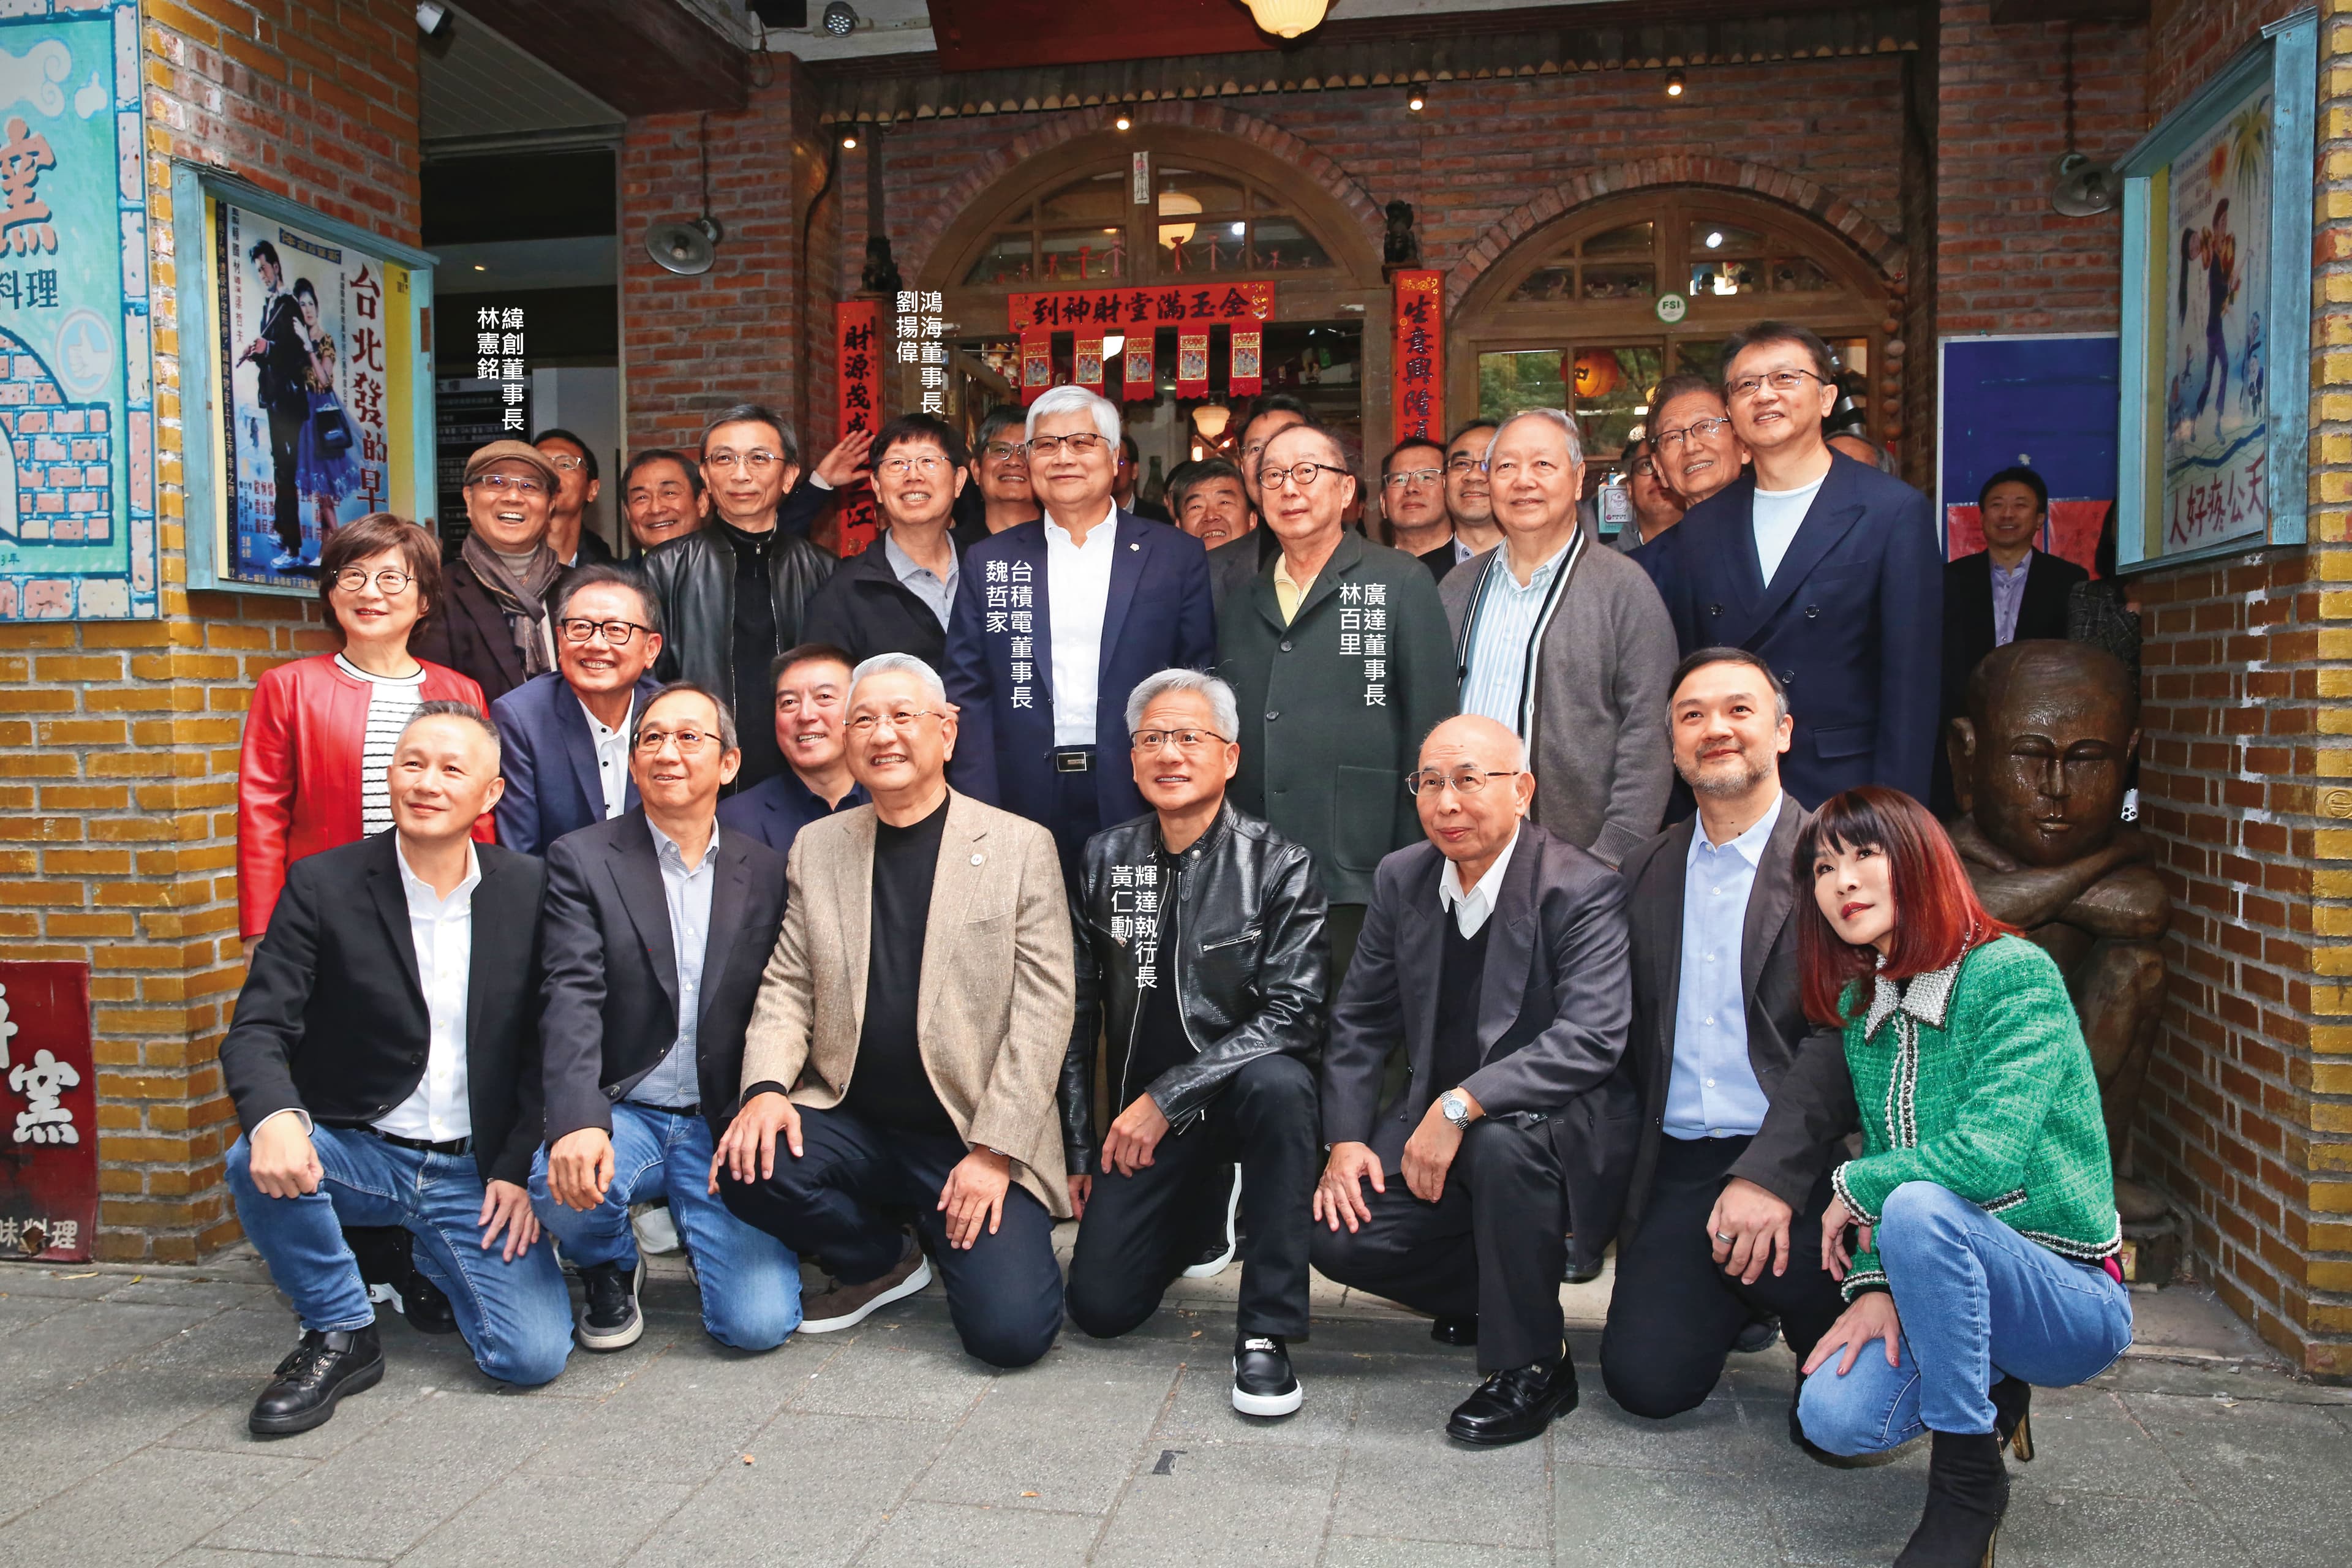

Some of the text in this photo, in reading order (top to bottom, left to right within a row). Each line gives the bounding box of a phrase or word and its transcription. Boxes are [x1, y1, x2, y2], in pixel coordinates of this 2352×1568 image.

[1662, 300, 1680, 309] FSI
[350, 262, 387, 513] 台北發的早
